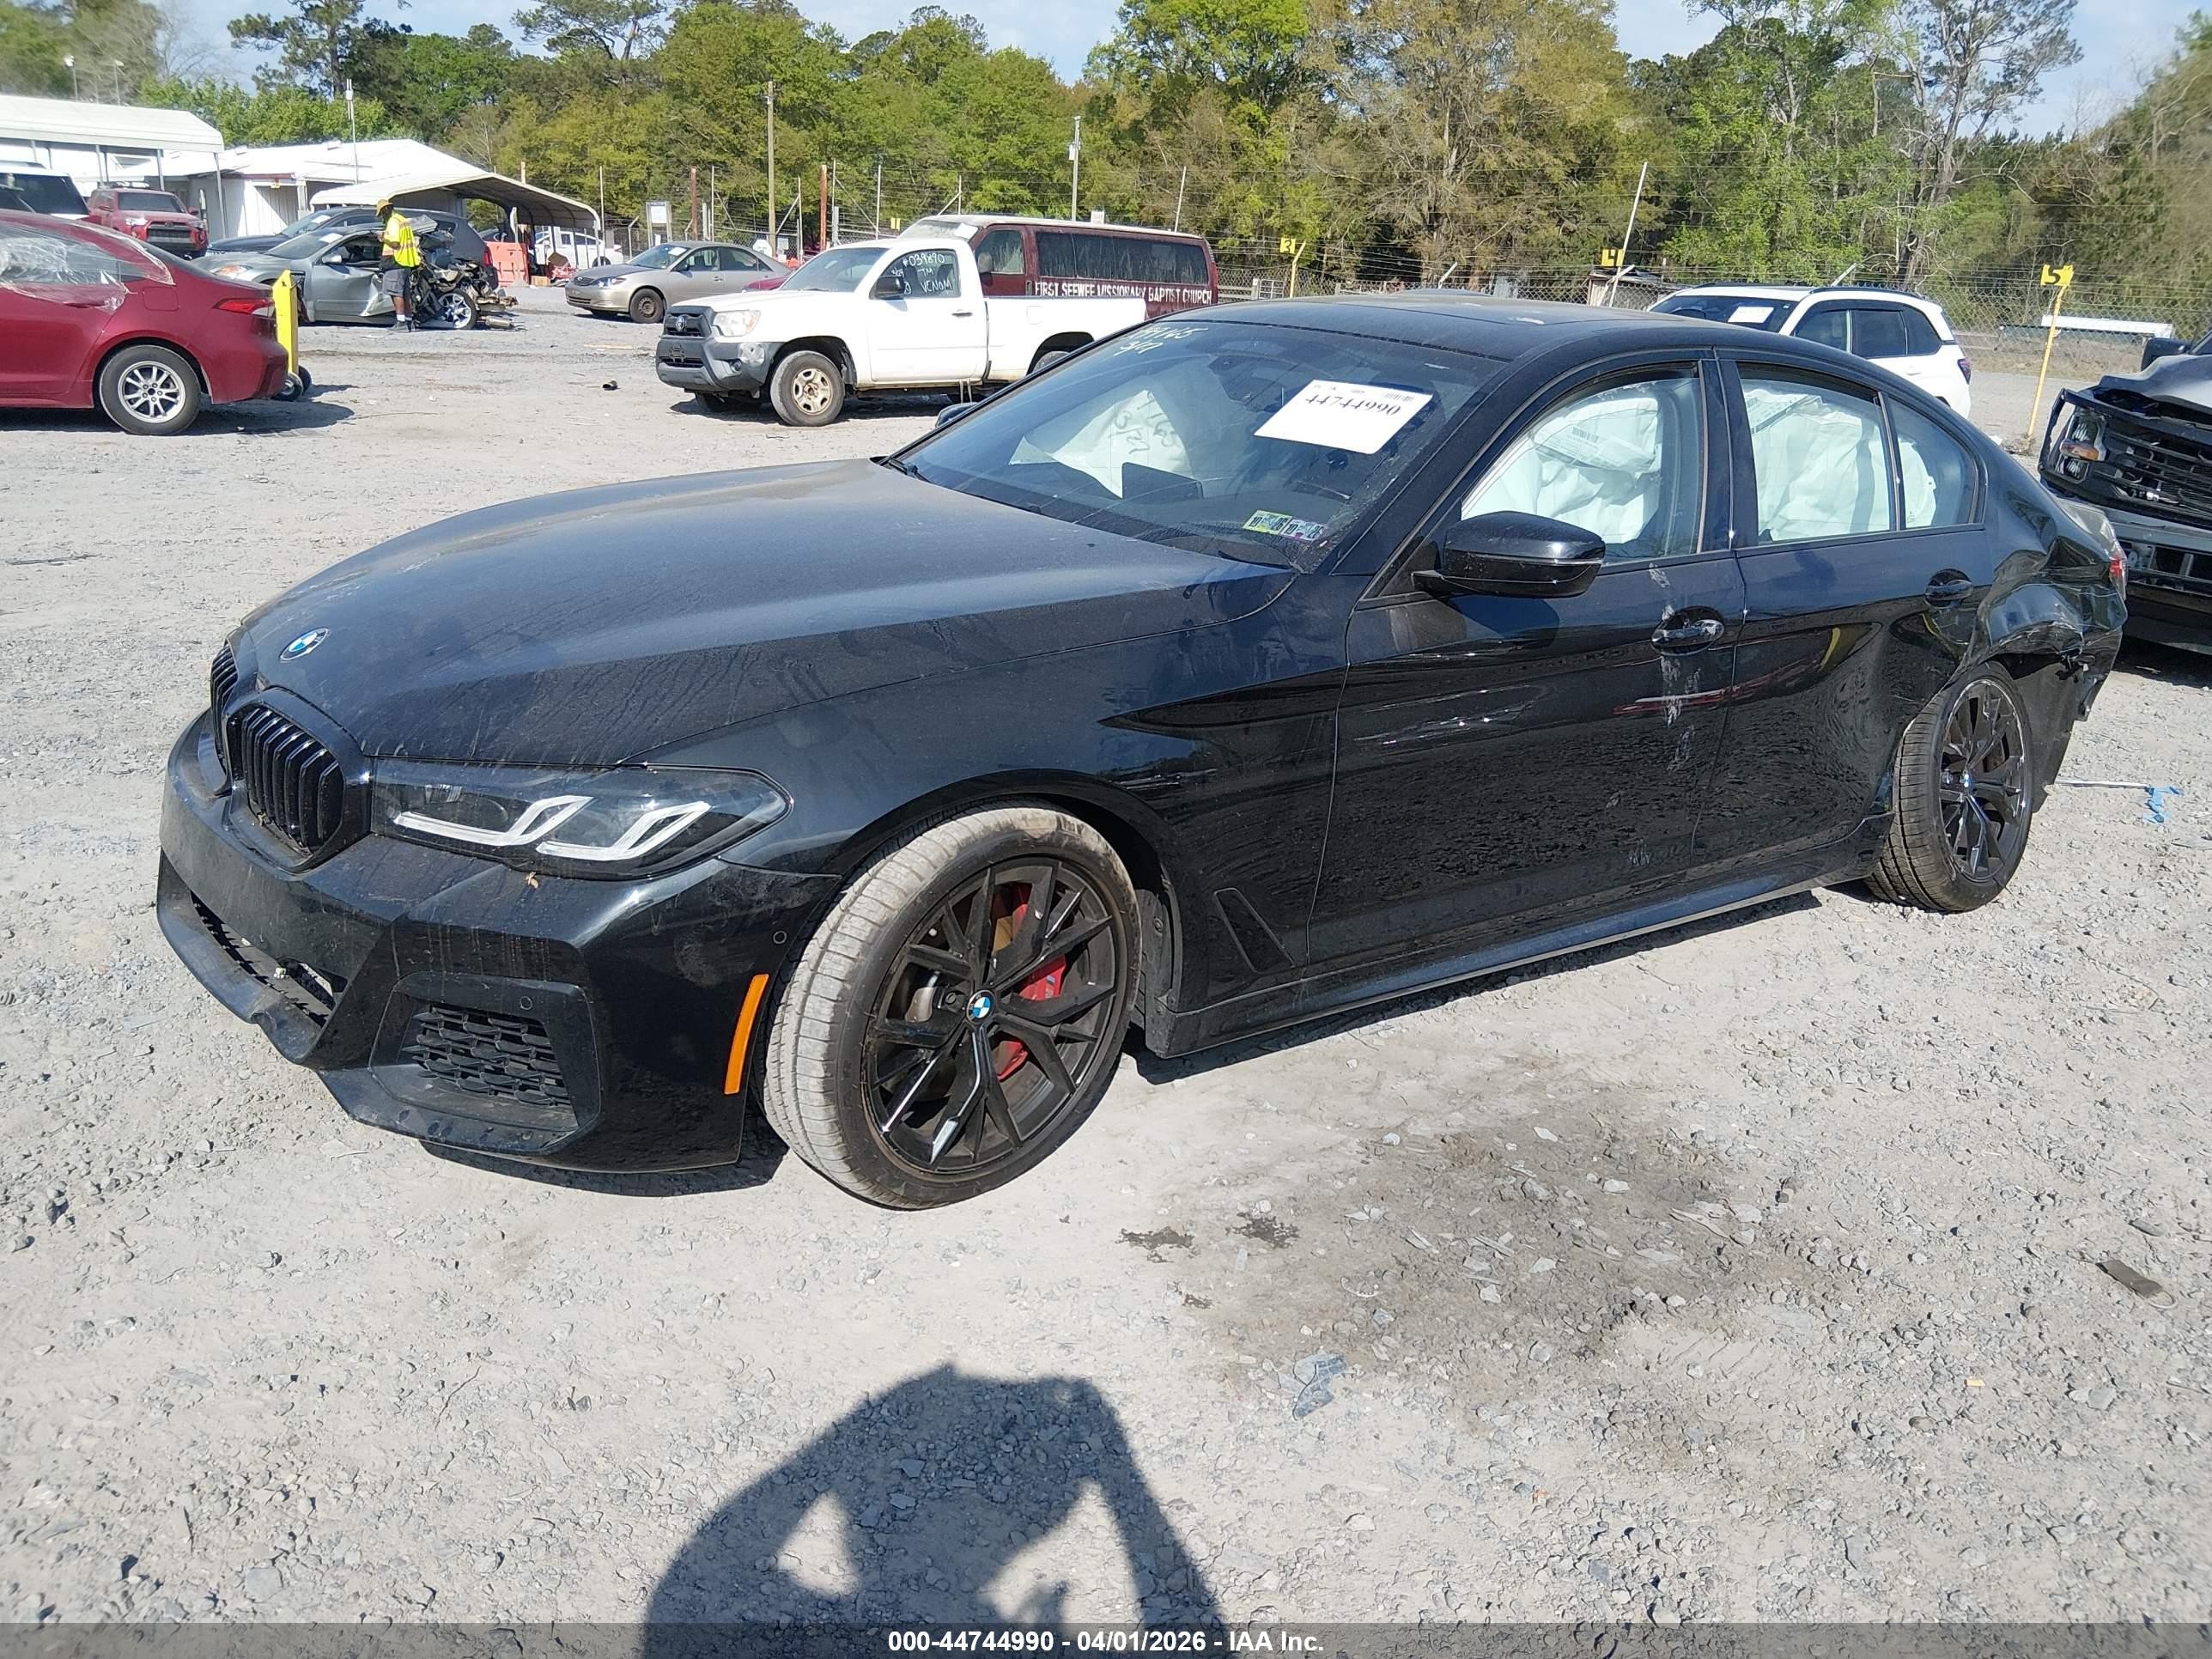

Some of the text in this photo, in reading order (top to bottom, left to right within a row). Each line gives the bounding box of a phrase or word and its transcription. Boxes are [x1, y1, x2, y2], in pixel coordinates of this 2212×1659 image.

[1284, 240, 1292, 253] 3
[1607, 249, 1620, 266] 4
[2045, 266, 2063, 284] 5
[921, 279, 953, 293] VENOM
[1035, 282, 1059, 297] FIRST
[1148, 286, 1181, 303] BAPTIST
[1182, 288, 1212, 304] CHURCH
[1305, 394, 1401, 416] 44744990
